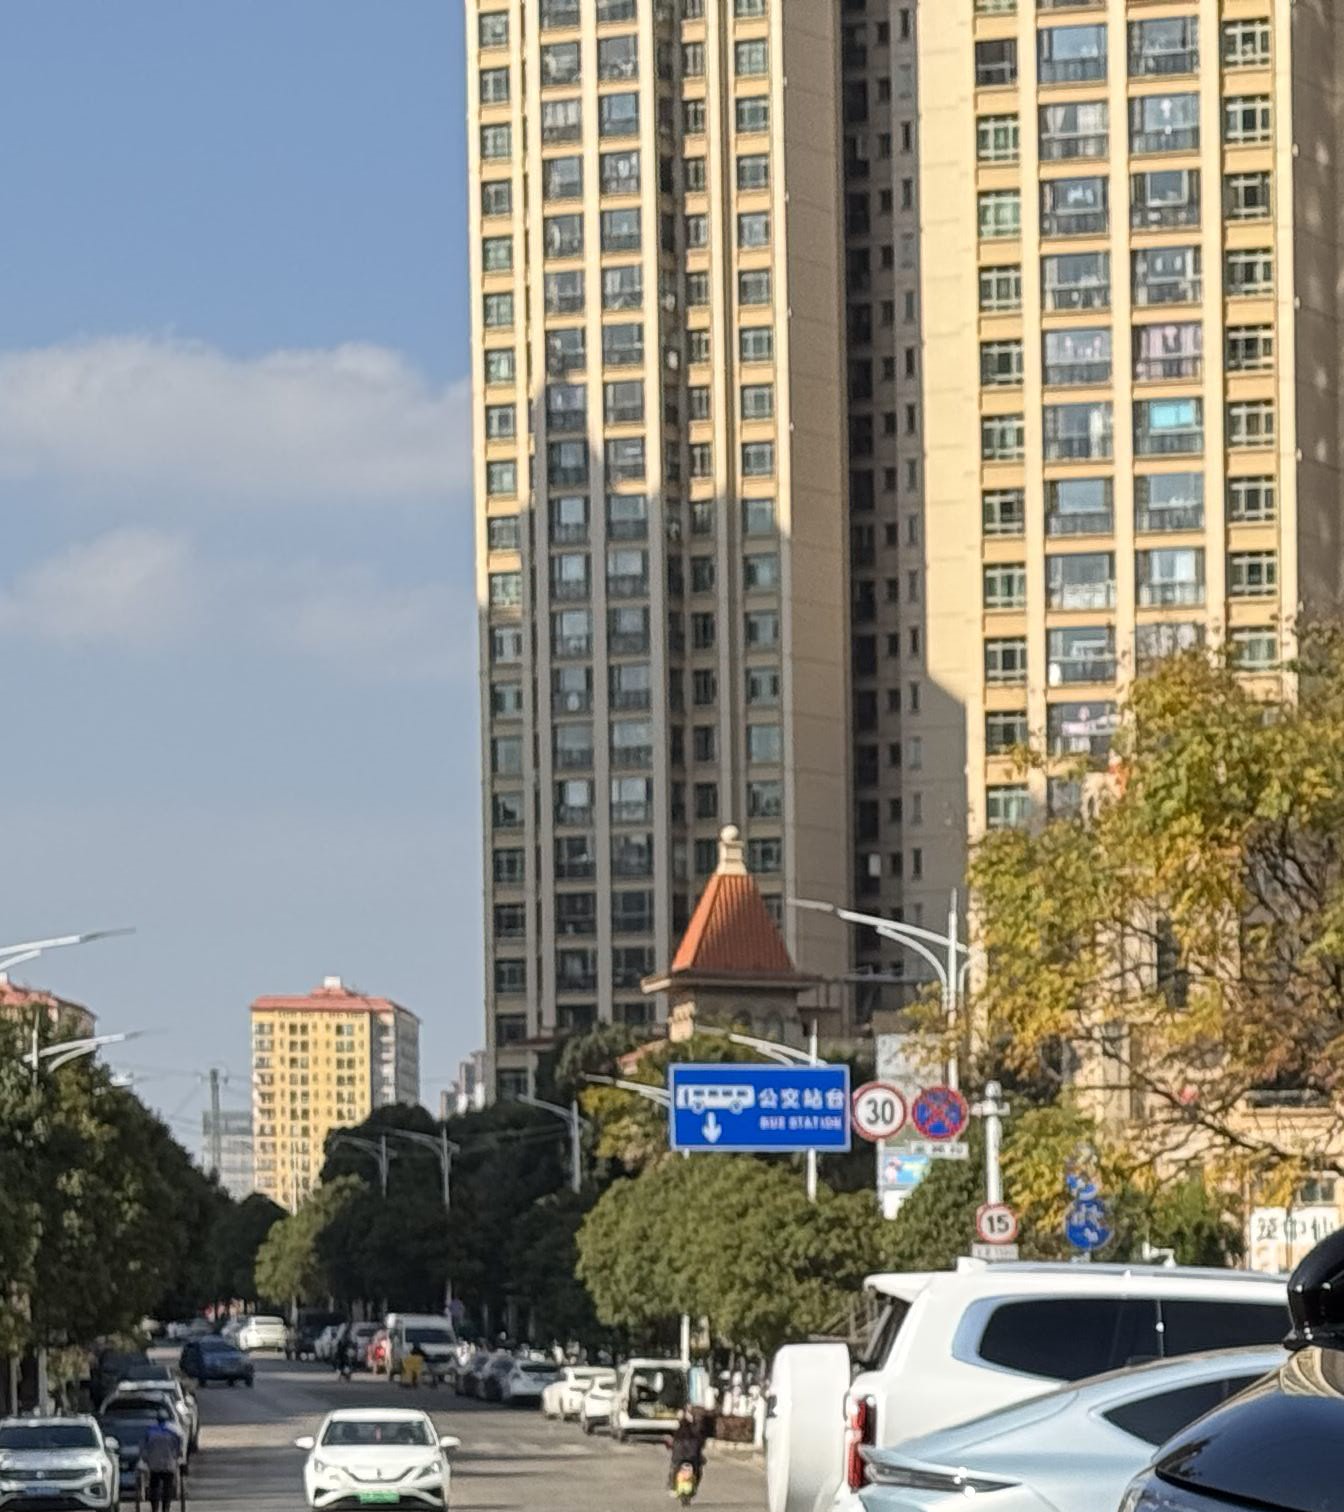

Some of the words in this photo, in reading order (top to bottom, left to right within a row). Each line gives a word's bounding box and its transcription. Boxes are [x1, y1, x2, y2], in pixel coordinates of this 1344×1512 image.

[759, 1087, 844, 1110] 公交站台
[866, 1097, 895, 1126] 30
[987, 1213, 1010, 1234] 15
